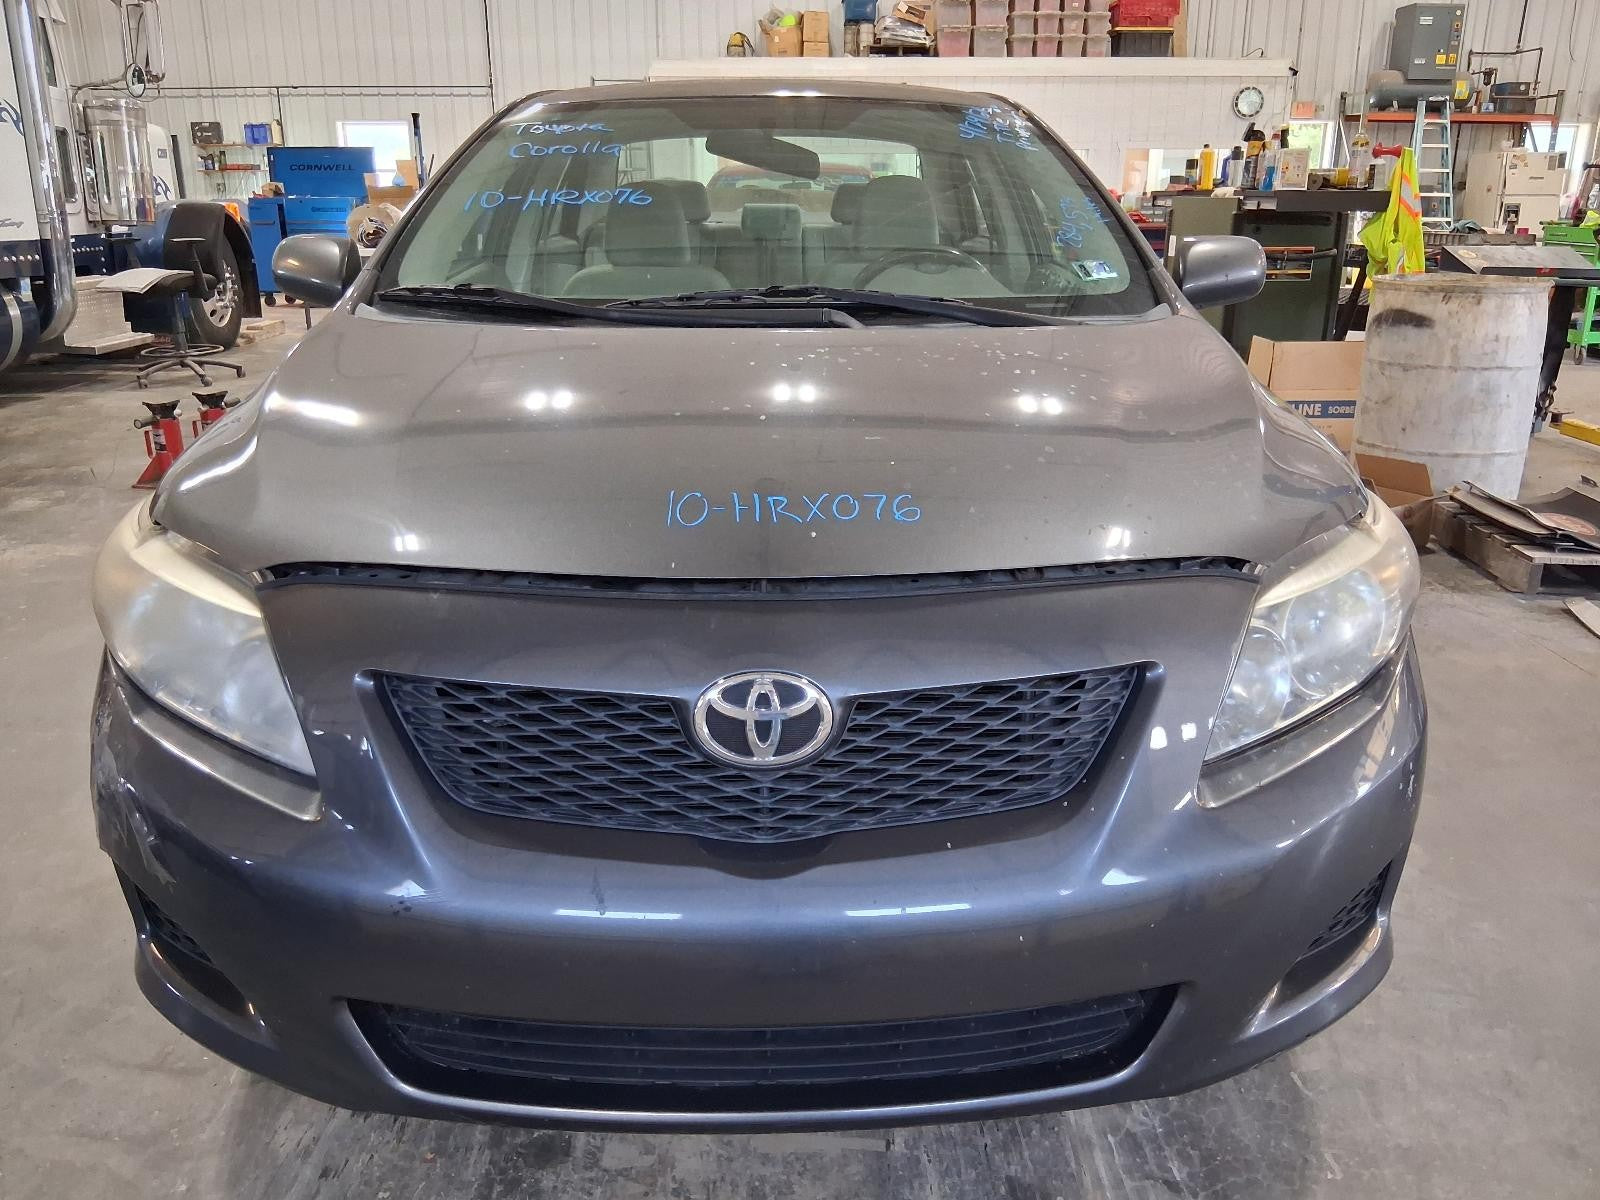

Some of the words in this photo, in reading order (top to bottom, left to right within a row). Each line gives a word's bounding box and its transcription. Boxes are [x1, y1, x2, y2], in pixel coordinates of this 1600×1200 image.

[509, 140, 622, 158] Corolla
[289, 163, 355, 172] CORNWELL
[463, 187, 653, 211] 10-HRX076
[667, 490, 921, 527] 10-HRX076
